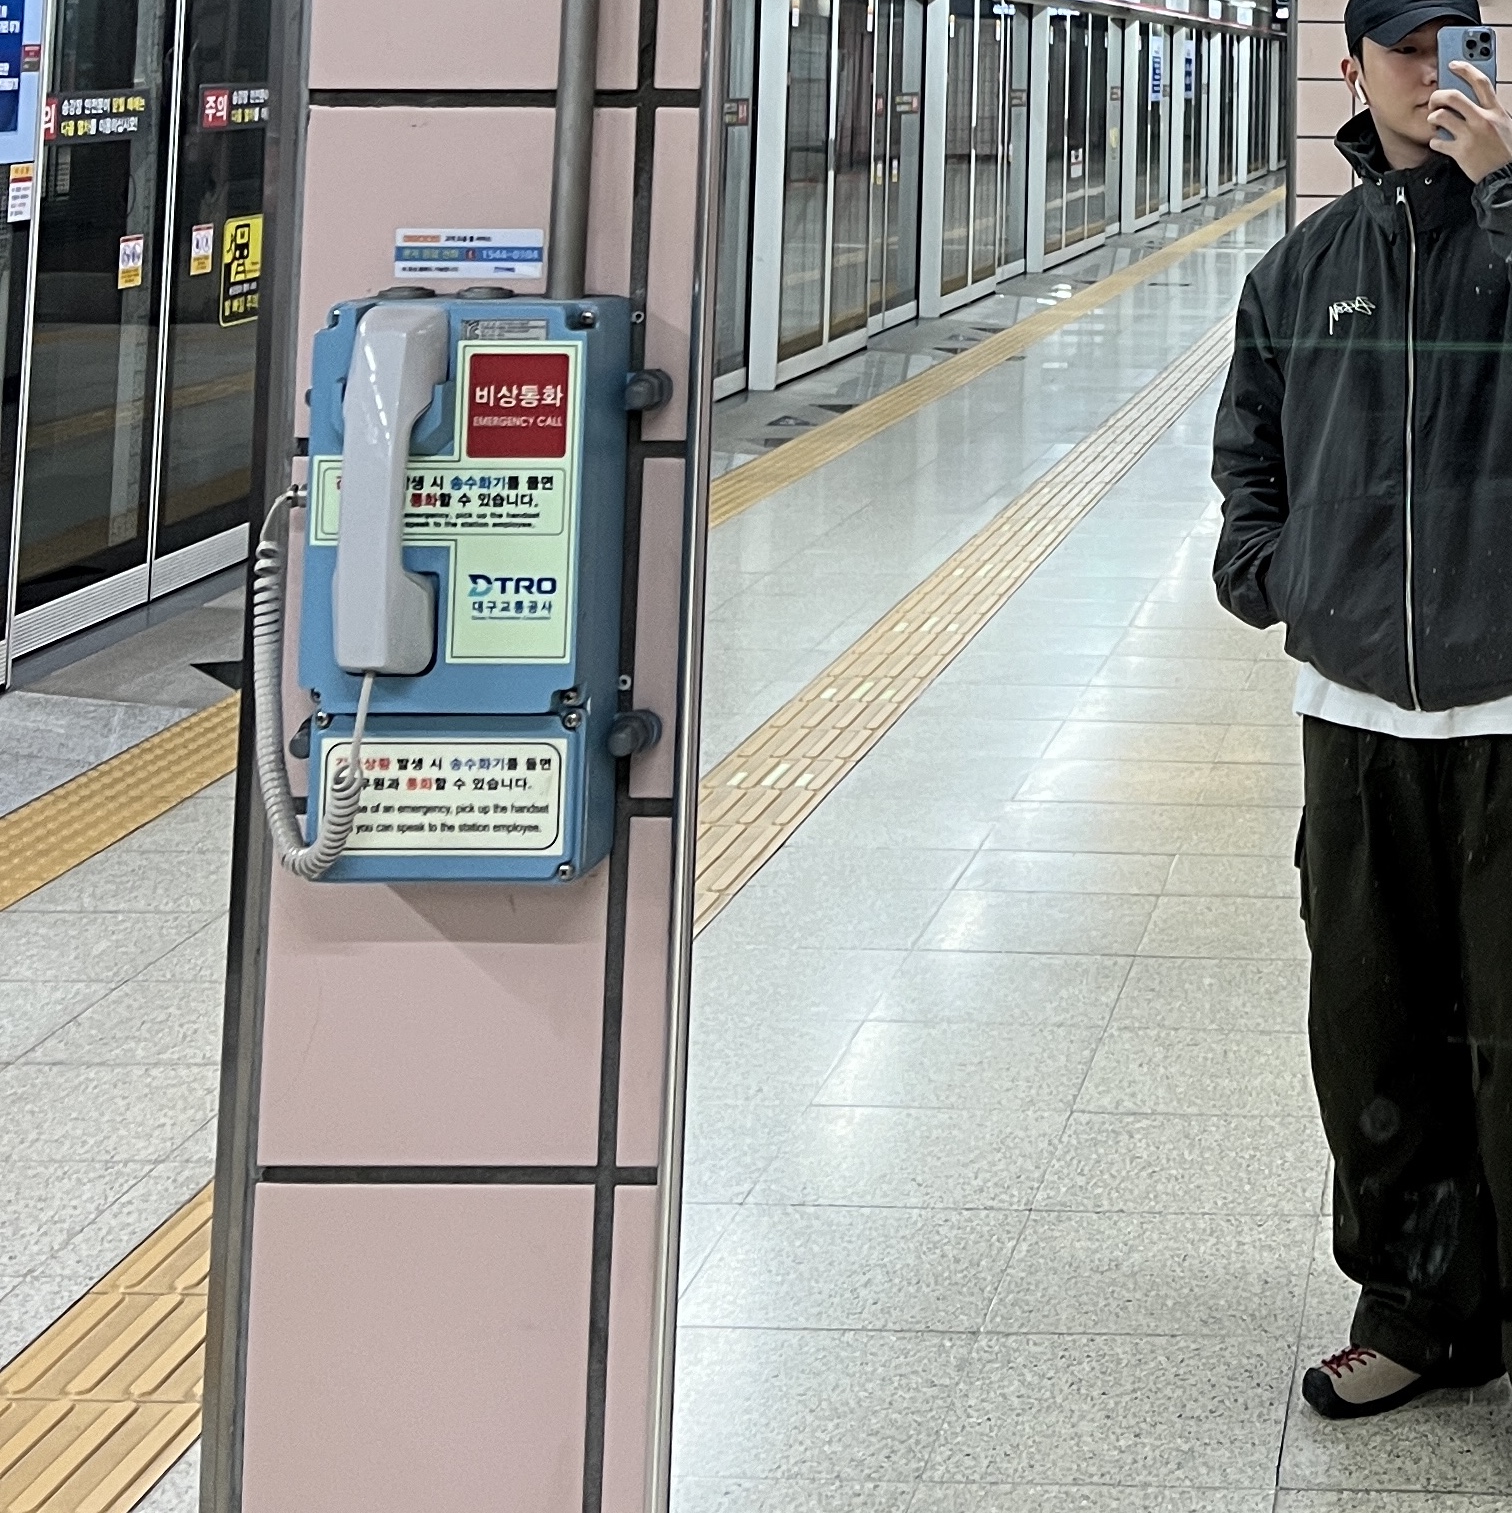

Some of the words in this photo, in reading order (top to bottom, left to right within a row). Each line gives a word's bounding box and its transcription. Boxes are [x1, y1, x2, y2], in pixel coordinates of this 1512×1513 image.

[203, 93, 229, 122] 주의
[43, 102, 56, 134] 의
[475, 384, 564, 407] 비상통화
[473, 416, 535, 427] EMERGENCY
[536, 416, 563, 427] CALL
[430, 474, 444, 491] 시
[457, 492, 472, 508] 수
[477, 492, 539, 508] 있습니다.
[467, 574, 557, 598] DTRO
[396, 757, 423, 772] 발생
[430, 757, 443, 772] 시
[450, 757, 518, 772] 송수화기를
[525, 757, 552, 772] 들면
[452, 777, 466, 791] 수
[471, 777, 533, 791] 있습니다.
[370, 803, 381, 814] of
[397, 805, 453, 816] emergency,
[455, 803, 475, 816] pick
[478, 804, 490, 815] up
[493, 802, 508, 813] the
[510, 802, 549, 814] handset
[355, 824, 373, 835] you
[375, 824, 394, 833] can
[396, 822, 425, 834] speak
[428, 822, 437, 833] to
[440, 822, 455, 833] the
[458, 822, 490, 833] station
[492, 823, 542, 835] employee.
